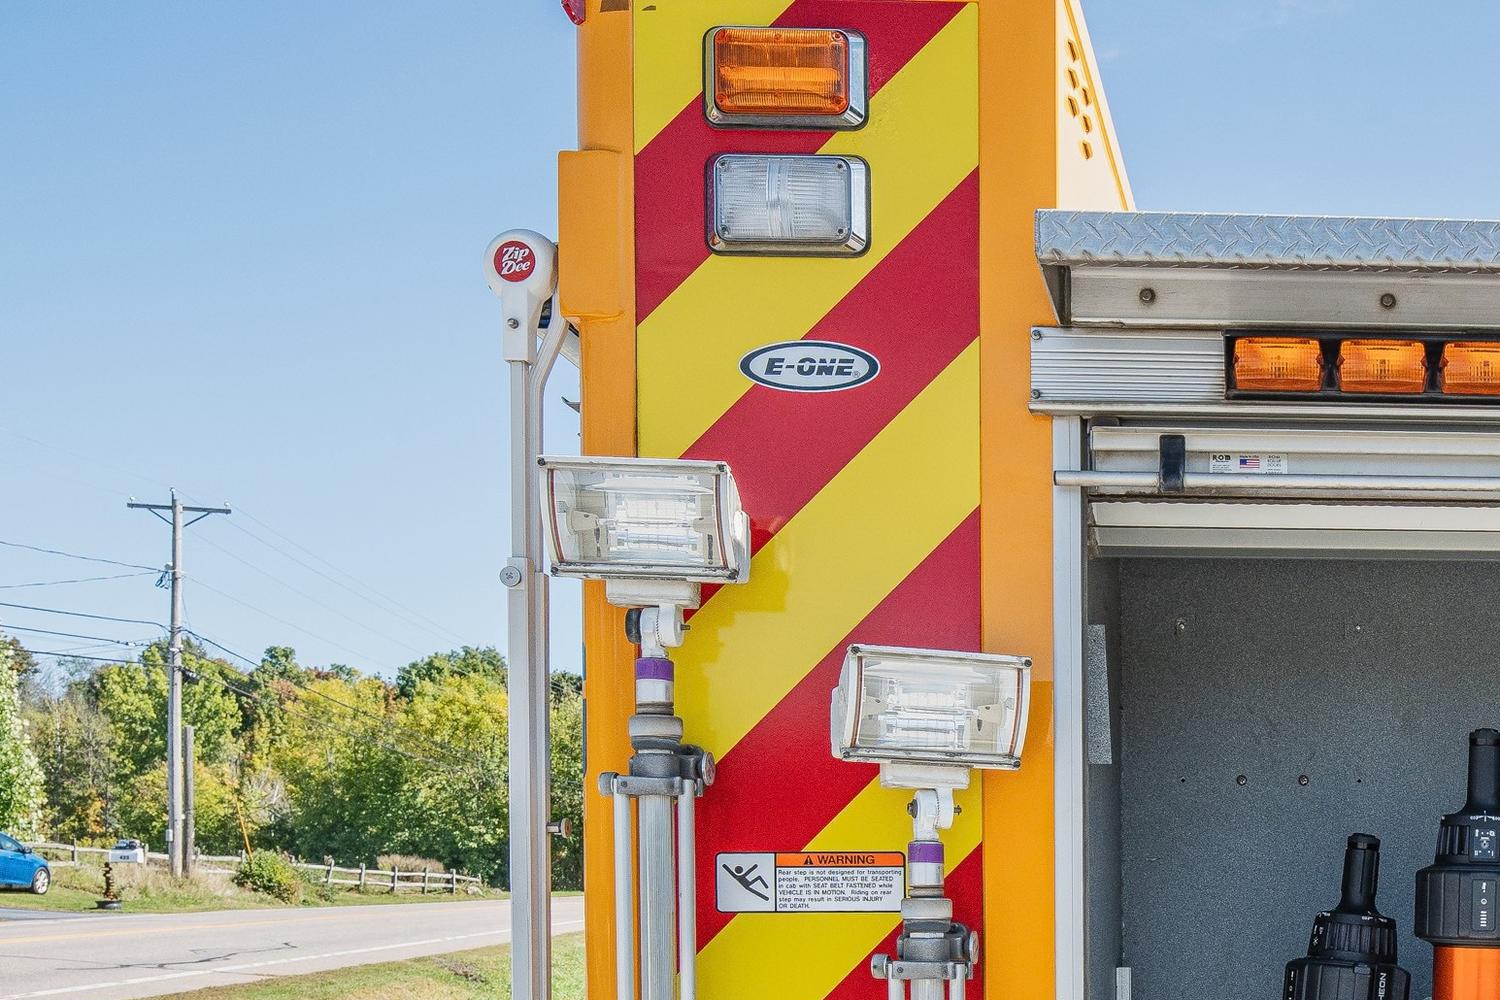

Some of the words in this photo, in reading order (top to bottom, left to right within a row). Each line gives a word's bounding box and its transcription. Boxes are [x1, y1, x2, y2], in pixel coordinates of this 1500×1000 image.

[502, 246, 530, 263] Zip
[501, 260, 531, 275] Dee
[764, 357, 855, 376] E-ONE
[818, 855, 875, 864] WARNING
